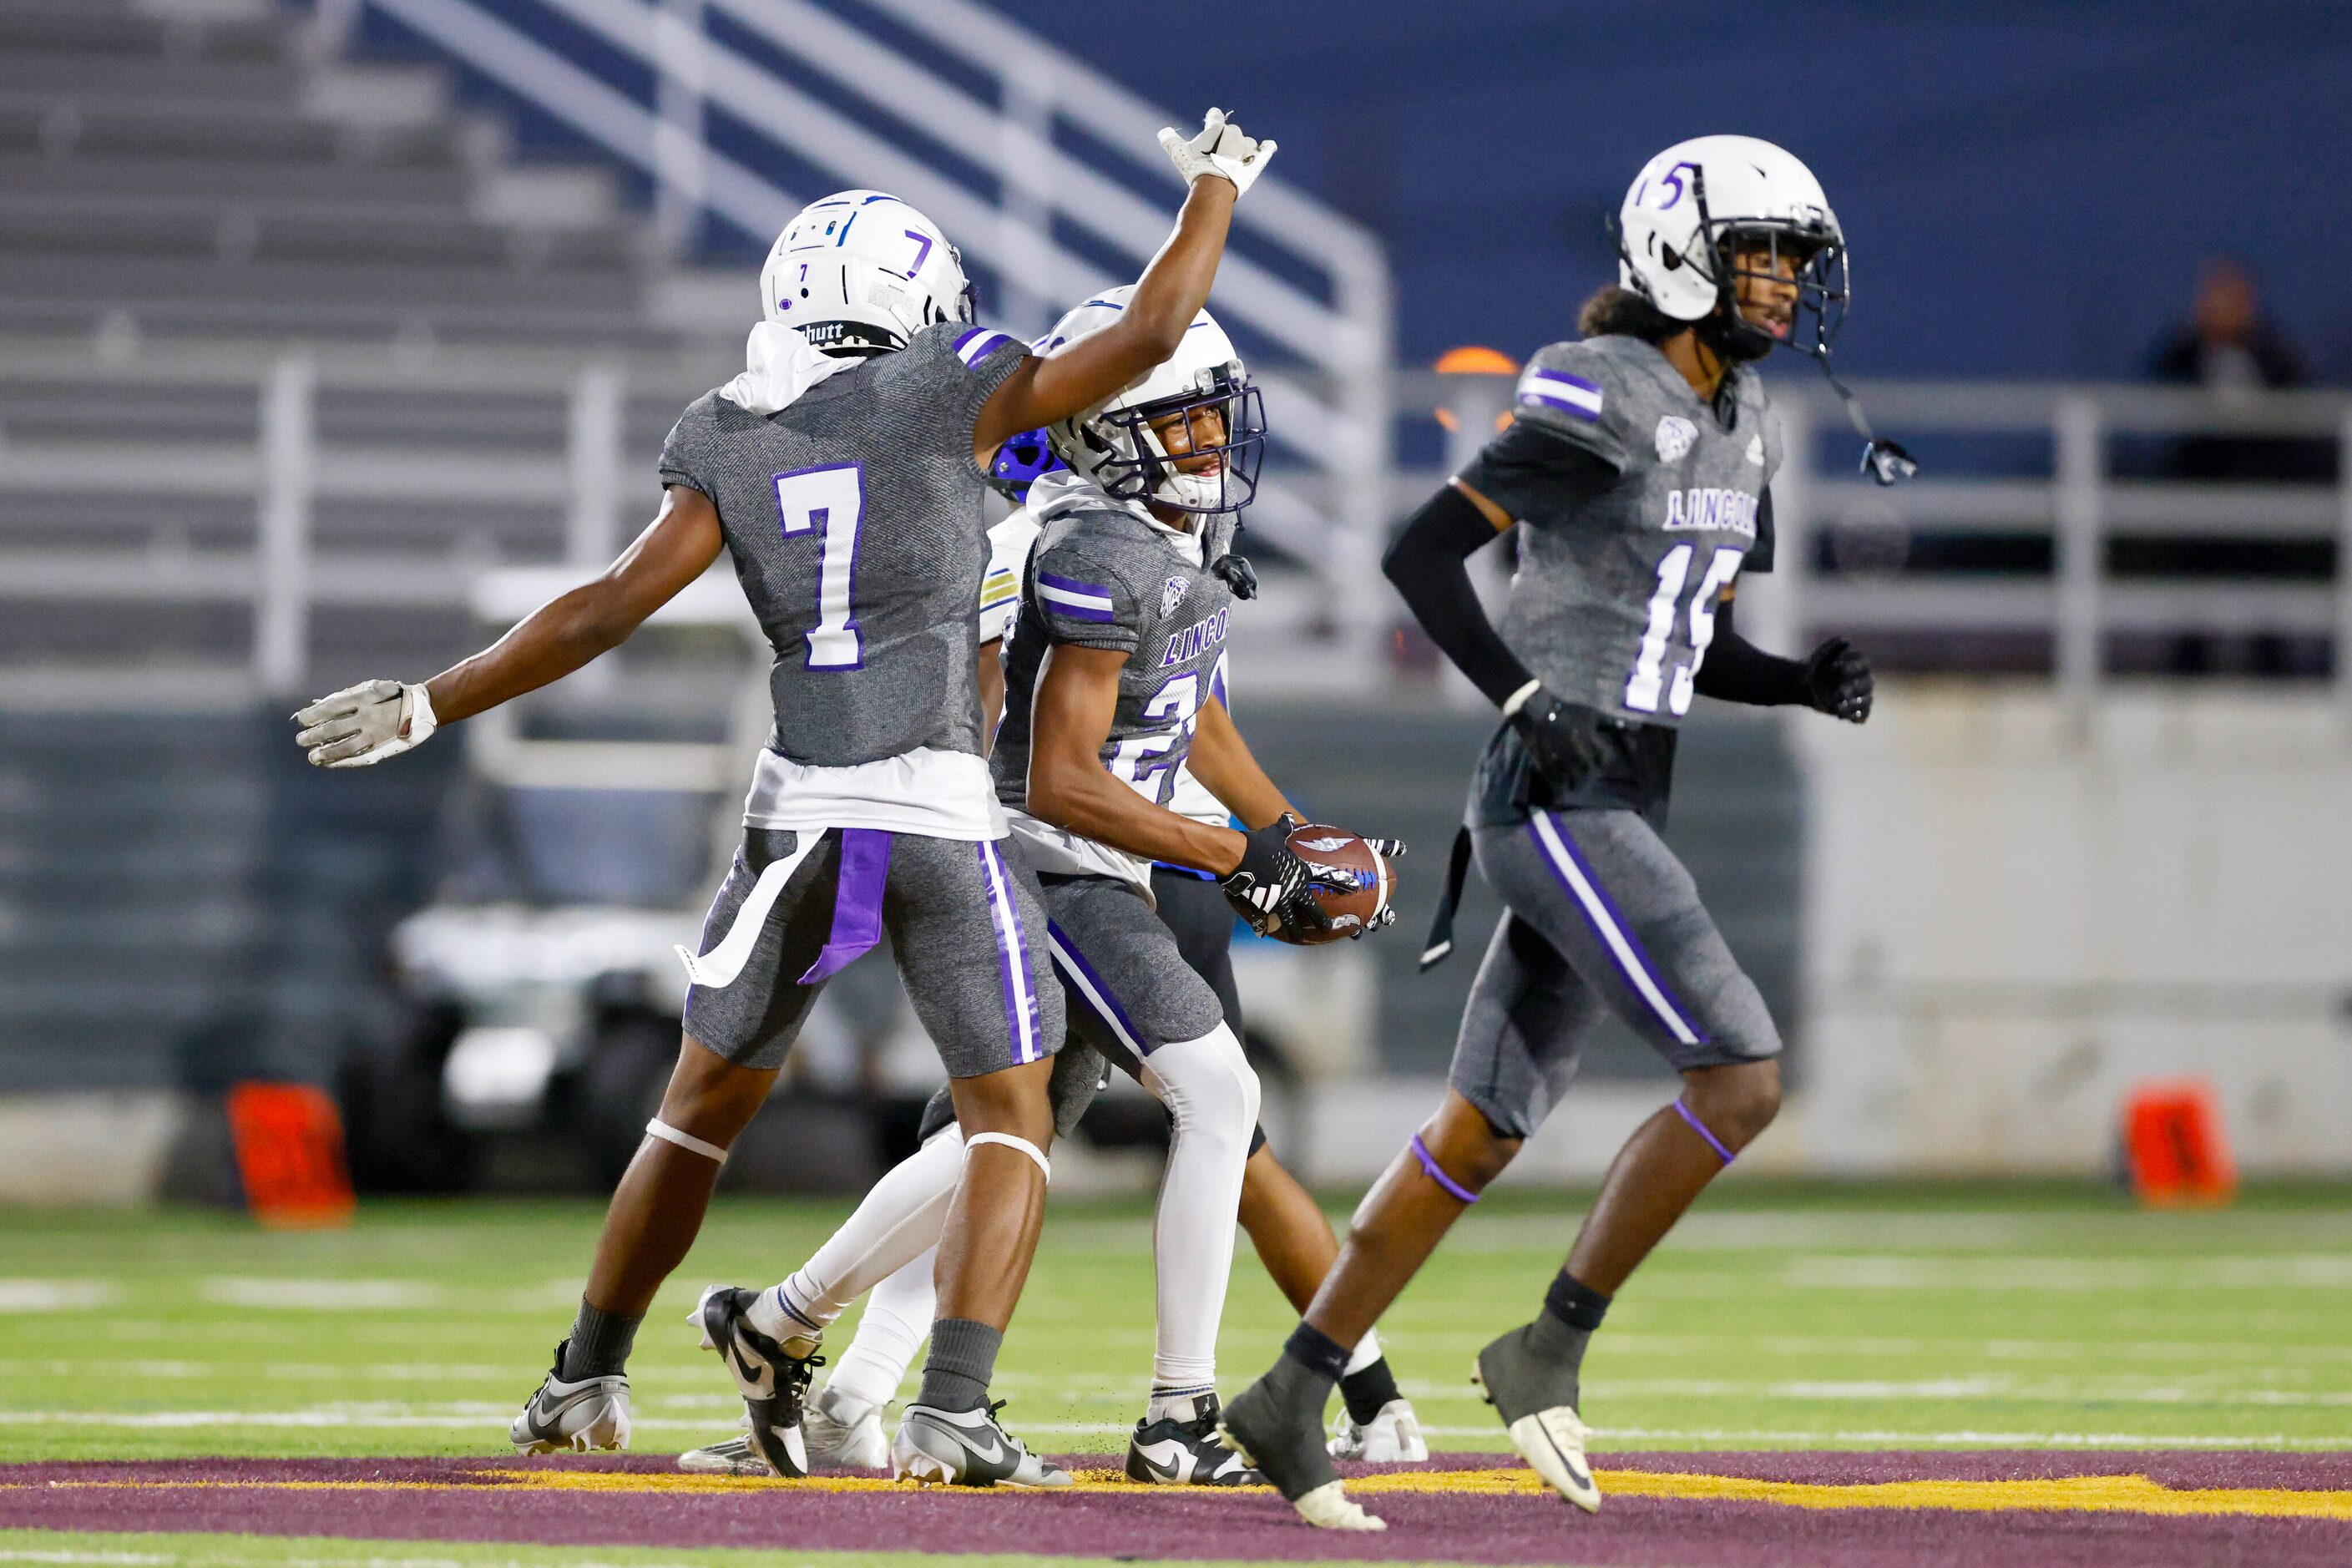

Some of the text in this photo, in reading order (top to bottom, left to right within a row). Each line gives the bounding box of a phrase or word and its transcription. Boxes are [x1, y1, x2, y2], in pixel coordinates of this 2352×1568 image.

[1636, 159, 1697, 210] 15
[800, 264, 808, 282] 7
[905, 230, 932, 279] 7
[771, 460, 867, 671] 7
[1158, 600, 1233, 669] LINCO
[1623, 540, 1746, 718] 15
